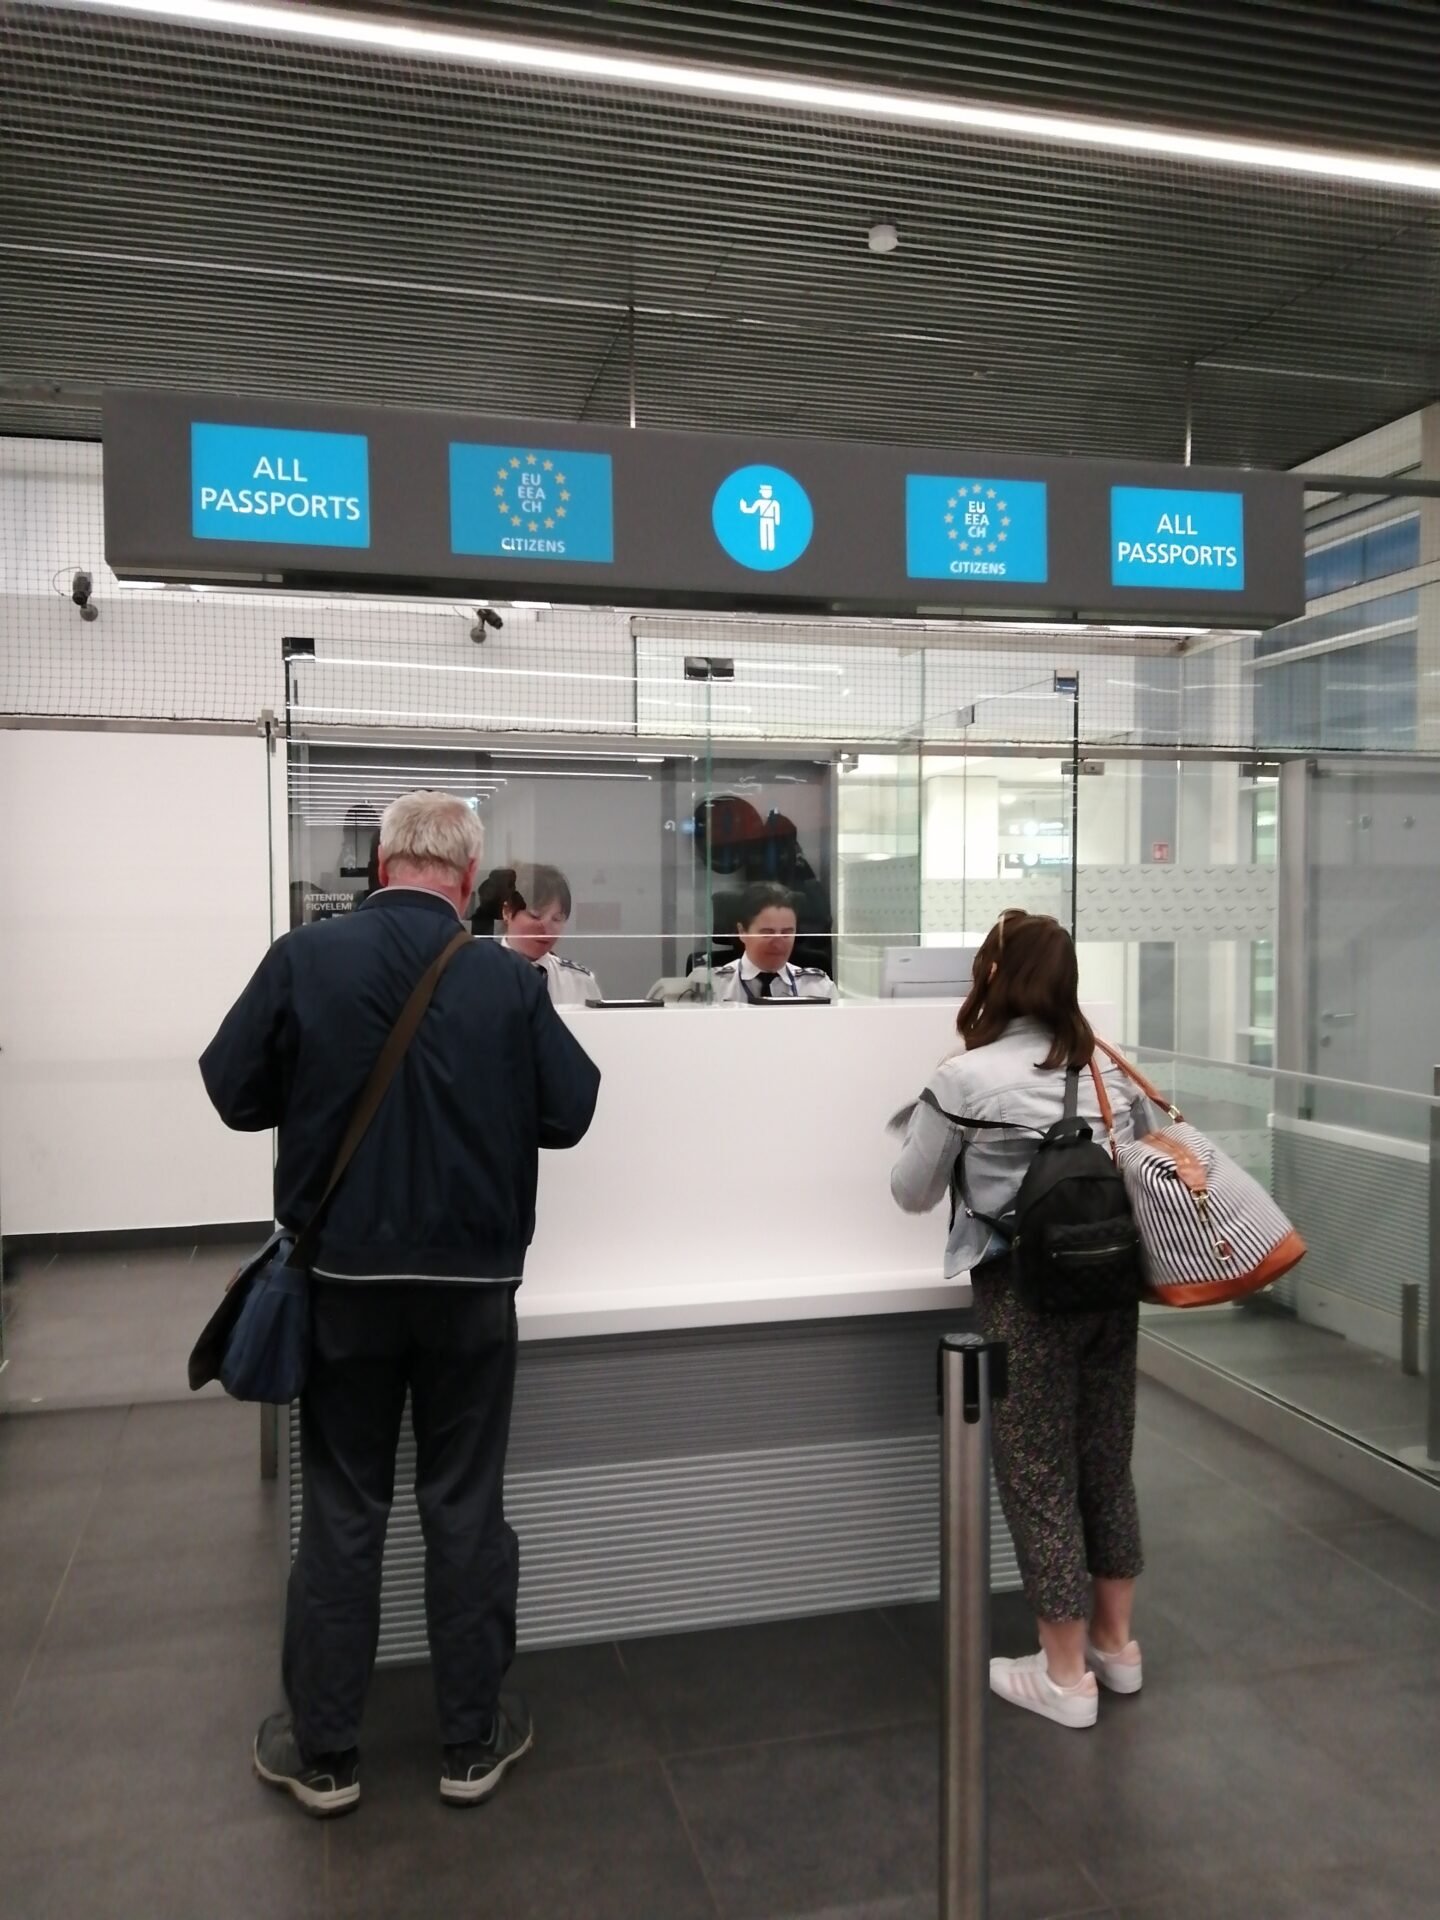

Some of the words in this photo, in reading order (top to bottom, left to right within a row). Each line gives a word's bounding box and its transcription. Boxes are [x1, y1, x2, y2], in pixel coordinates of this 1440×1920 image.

[253, 456, 308, 482] ALL
[522, 473, 541, 486] EU
[518, 486, 546, 500] EEA
[201, 487, 361, 520] PASSPORTS
[522, 500, 542, 513] CH
[969, 501, 986, 513] EU
[965, 513, 990, 526] EEA
[1157, 513, 1198, 535] ALL
[968, 526, 987, 538] CH
[501, 537, 566, 553] CITIZENS
[1118, 541, 1237, 567] PASSPORTS
[950, 561, 1006, 575] CITIZENS
[304, 893, 354, 902] ATTENTION
